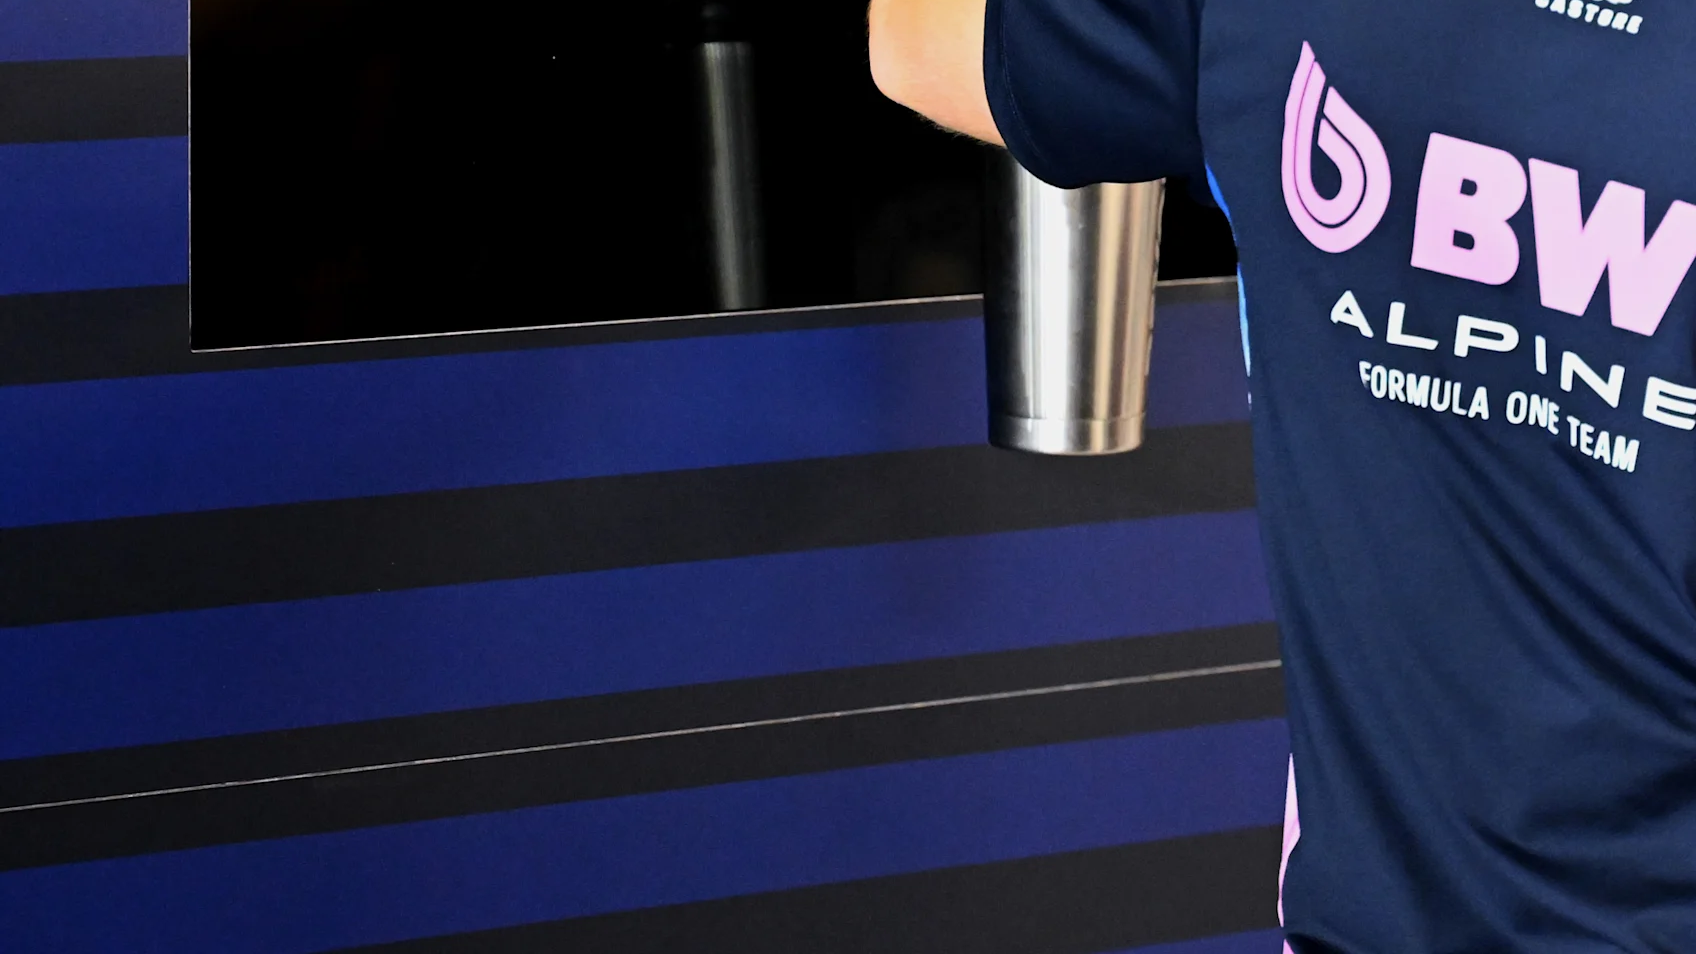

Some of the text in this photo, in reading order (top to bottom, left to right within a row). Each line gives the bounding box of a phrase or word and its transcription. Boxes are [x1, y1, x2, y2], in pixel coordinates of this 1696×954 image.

[1358, 360, 1640, 473] FORMULA ONE TEAM
